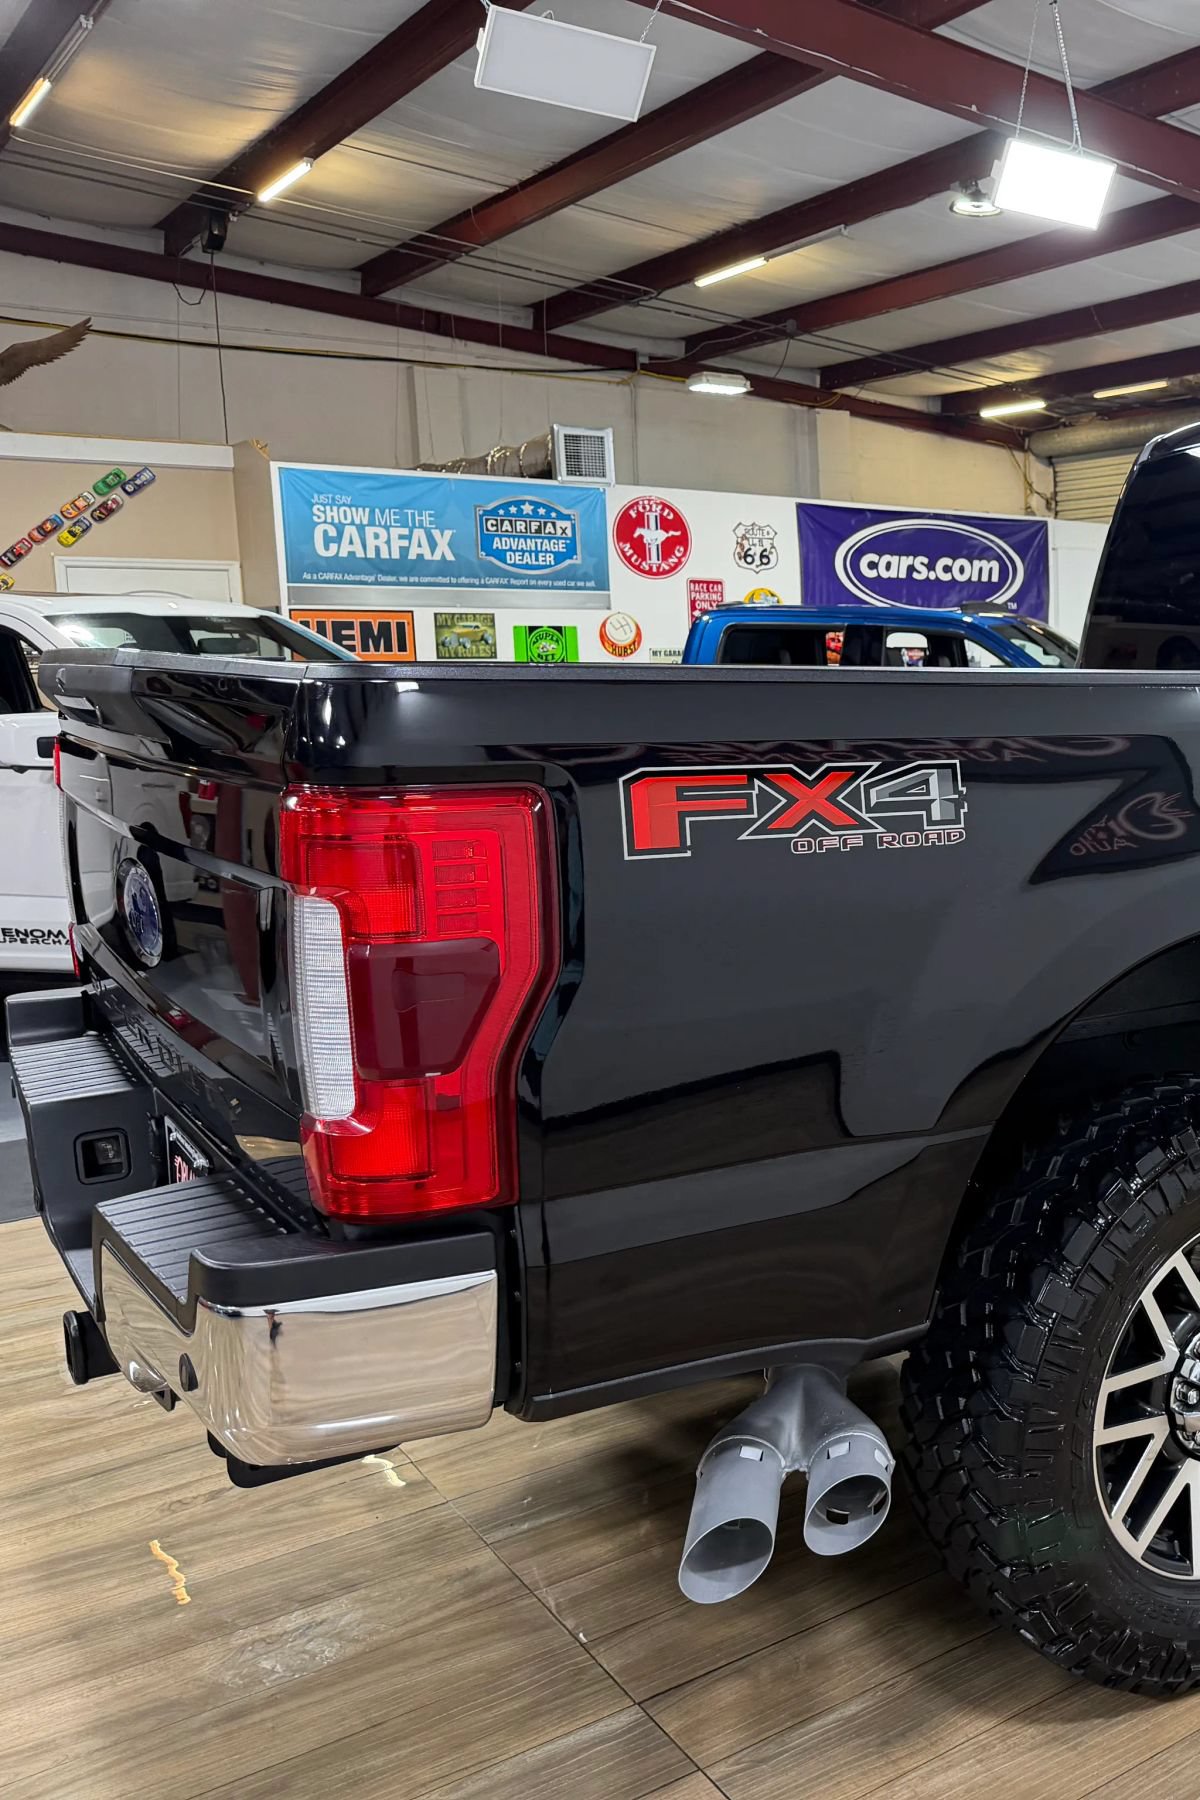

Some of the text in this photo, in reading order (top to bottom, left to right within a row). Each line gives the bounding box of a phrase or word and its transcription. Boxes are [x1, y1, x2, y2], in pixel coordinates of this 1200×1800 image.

[312, 493, 352, 504] JUST SAY
[312, 504, 436, 528] SHOW ME THE
[629, 502, 675, 520] FORD
[486, 518, 568, 536] CARFAX
[313, 523, 455, 561] CARFAX
[492, 536, 567, 552] ADVANTAGE
[506, 551, 555, 566] DEALER
[619, 541, 686, 573] MUSTANG
[743, 548, 771, 566] 66
[859, 552, 1000, 583] cars.com
[690, 582, 722, 593] RACE CAR
[691, 591, 722, 601] PARKING
[695, 600, 718, 610] ONLY
[436, 613, 494, 626] MY GARAGE
[438, 645, 460, 658] MY
[611, 642, 638, 657] HURST
[619, 760, 967, 860] FX4
[790, 828, 967, 855] OFF ROAD
